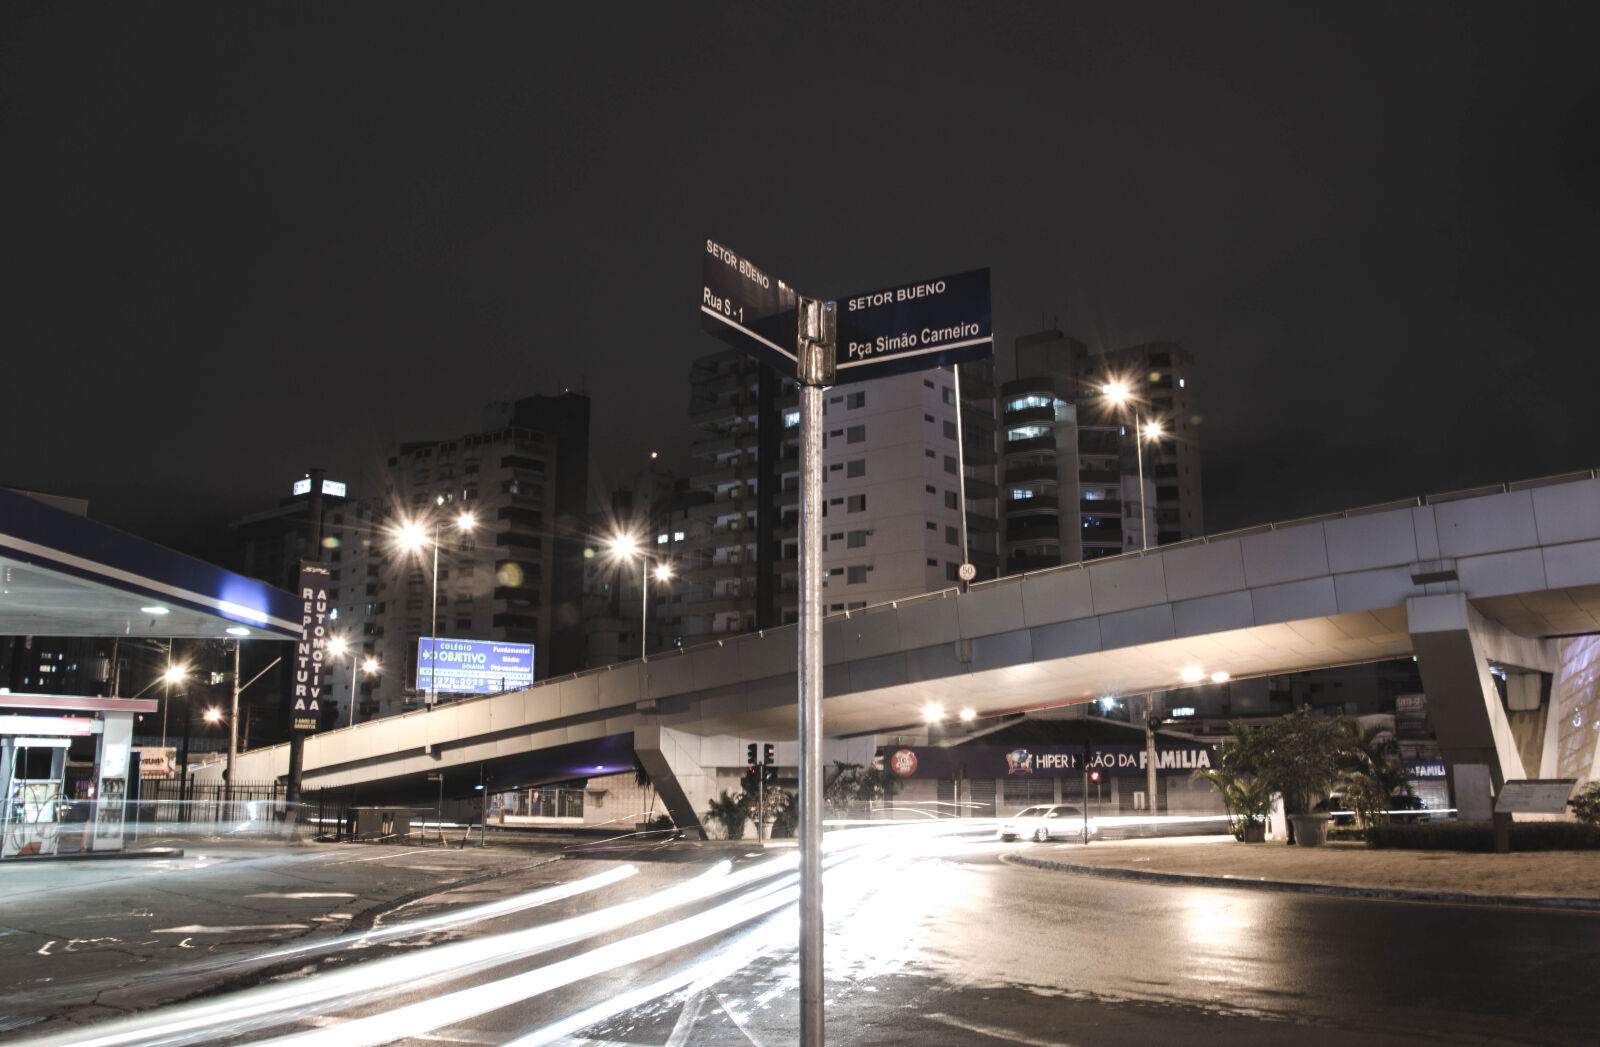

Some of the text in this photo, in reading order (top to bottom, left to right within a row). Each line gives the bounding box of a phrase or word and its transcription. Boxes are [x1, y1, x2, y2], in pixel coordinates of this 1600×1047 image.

[706, 239, 769, 289] SETOR BUENO
[703, 286, 722, 312] Rua
[848, 281, 946, 312] SETOR BUENO
[849, 321, 980, 360] Pça Simão Carneiro
[294, 588, 314, 711] REPINTURA
[309, 589, 327, 711] AUTOMOTIVA
[439, 651, 486, 663] OBJETIVO
[1036, 754, 1068, 769] HIPER
[1118, 754, 1137, 768] DA
